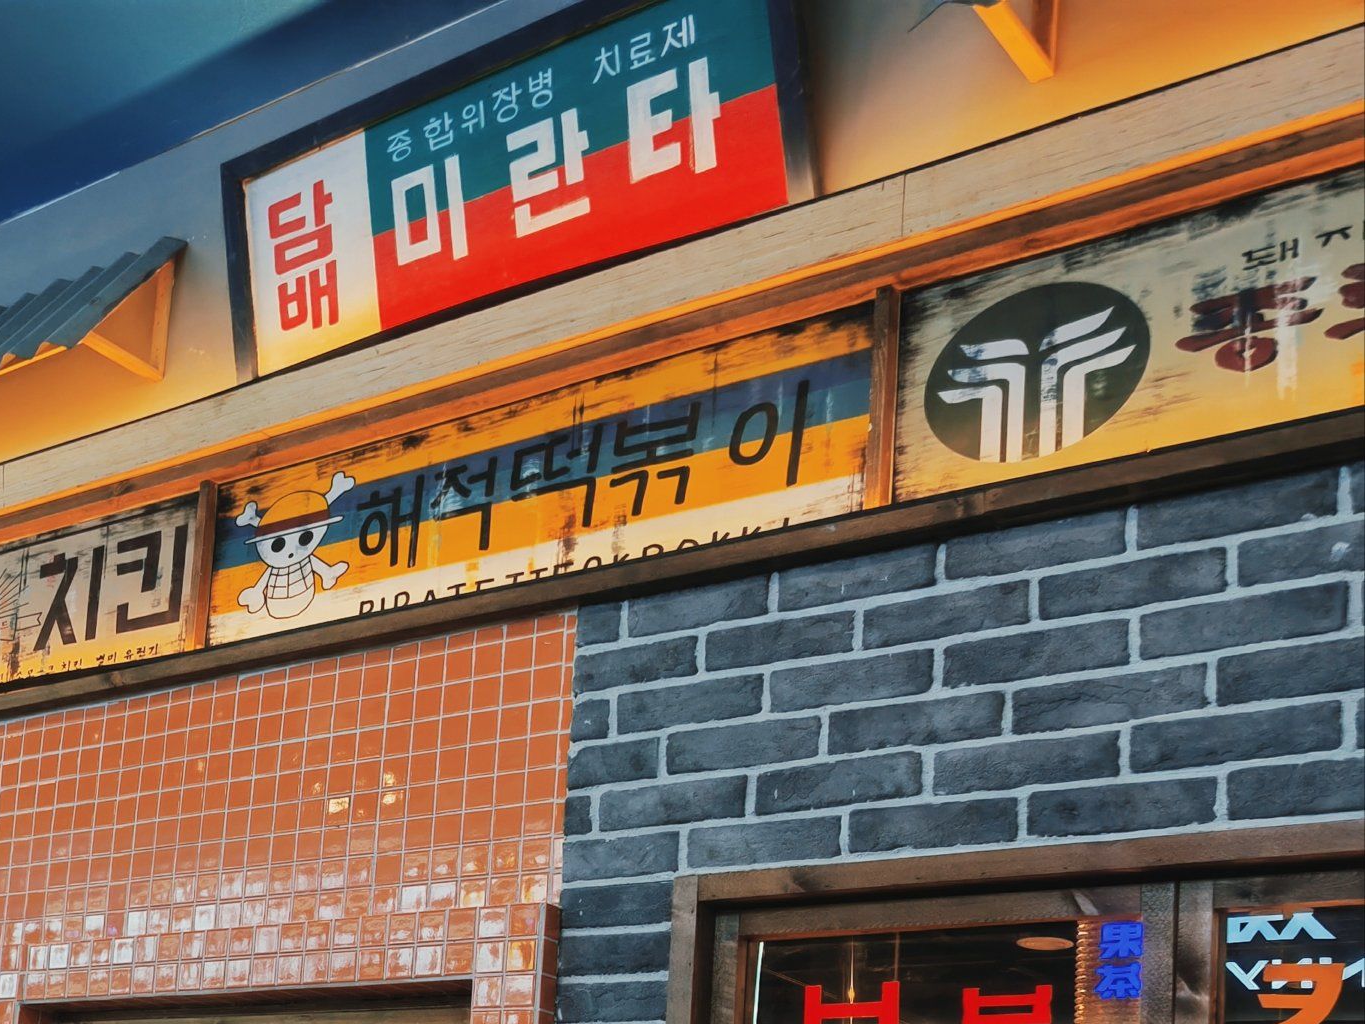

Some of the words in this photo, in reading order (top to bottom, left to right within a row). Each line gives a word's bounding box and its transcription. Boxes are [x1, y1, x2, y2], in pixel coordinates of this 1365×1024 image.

[386, 68, 555, 162] 종합위장병
[592, 13, 697, 85] 치료제
[390, 57, 721, 267] 미란타
[267, 179, 340, 332] 담배
[33, 524, 189, 651] 치킨
